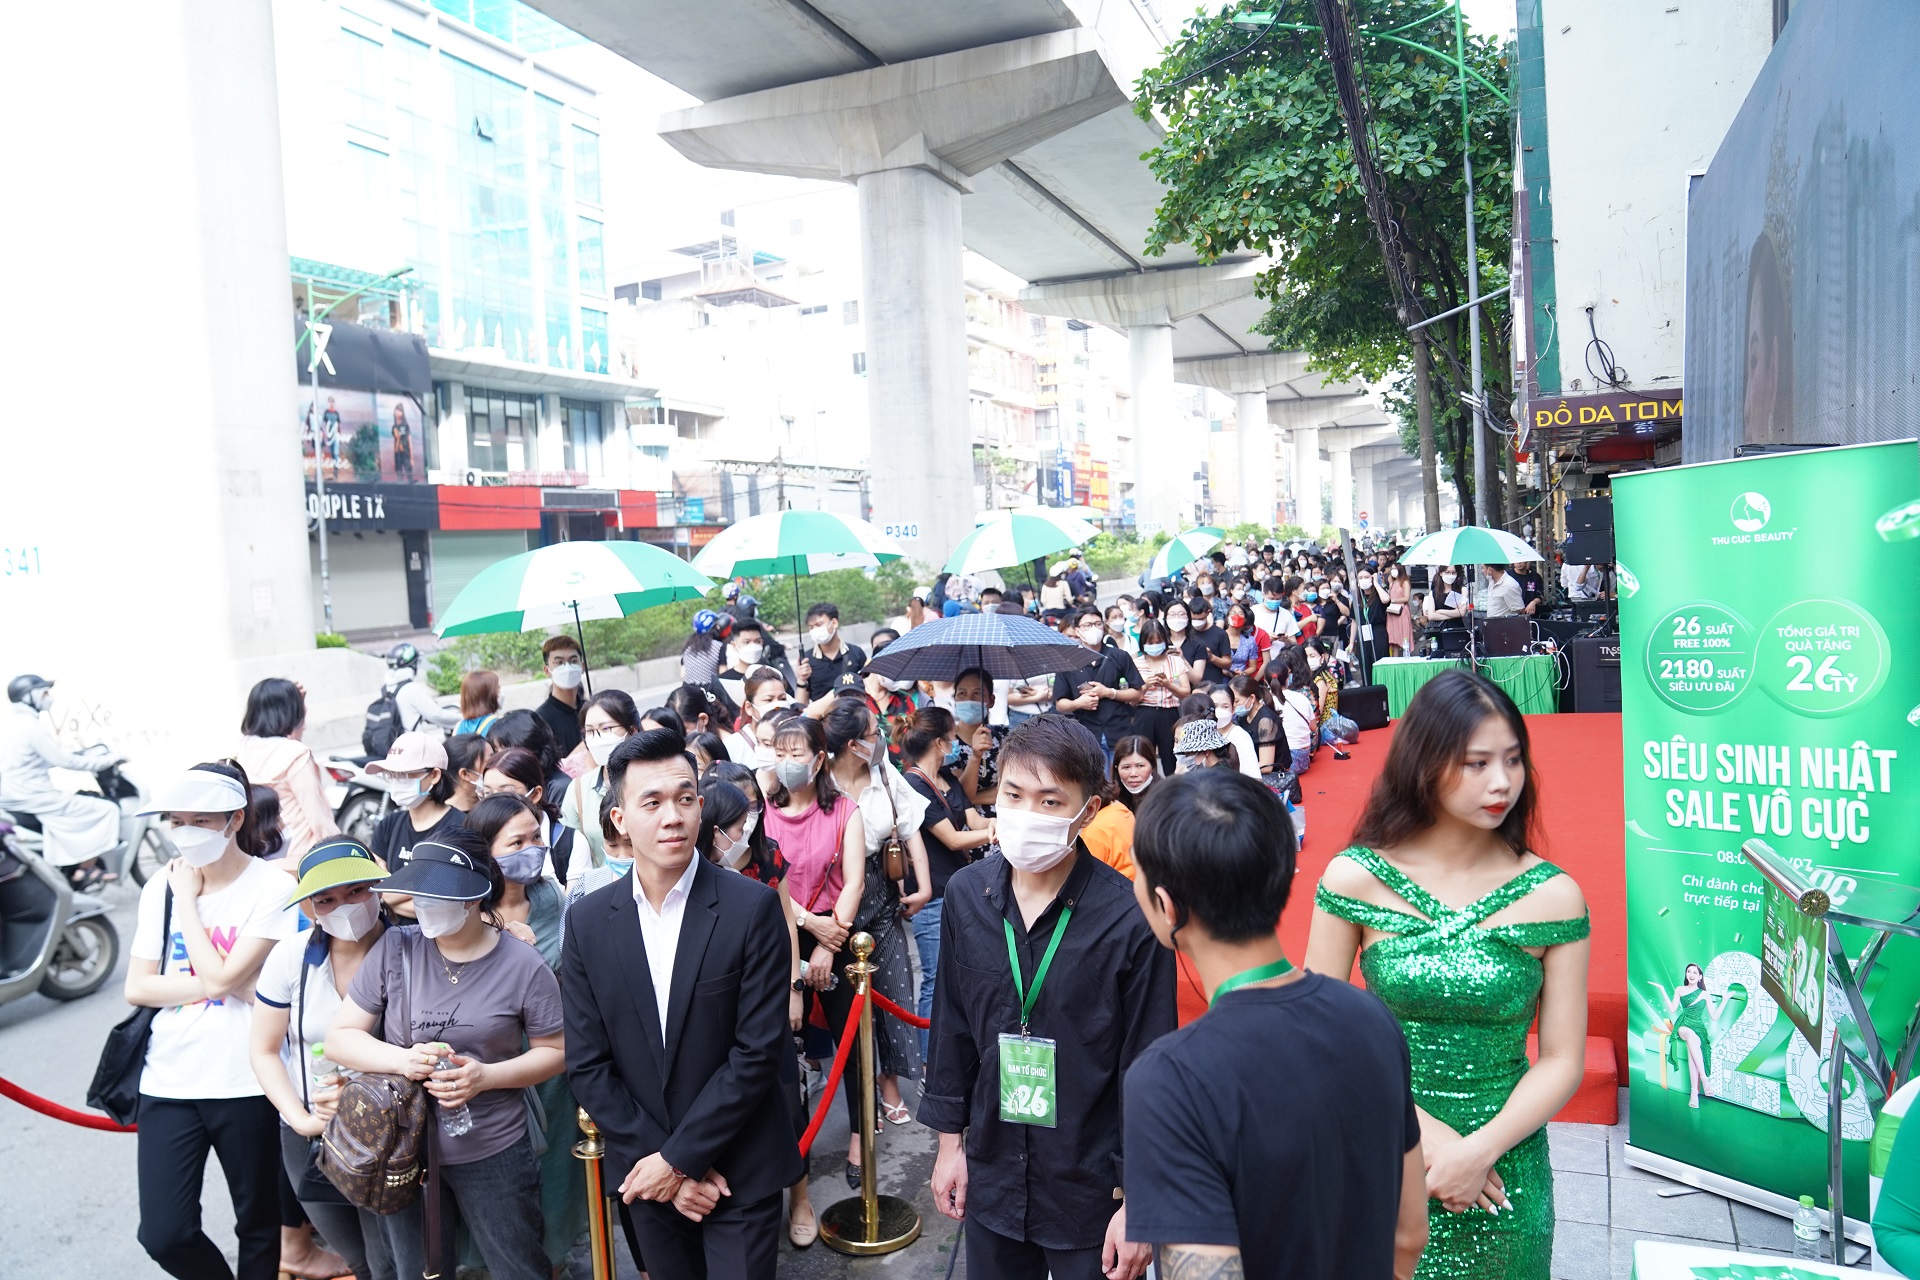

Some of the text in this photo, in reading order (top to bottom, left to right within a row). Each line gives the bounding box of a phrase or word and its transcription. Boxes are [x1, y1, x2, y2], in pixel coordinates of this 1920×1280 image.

[1535, 399, 1683, 427] ĐỒ DA TOM
[306, 493, 362, 519] OUPLE
[886, 525, 918, 539] P340
[1711, 531, 1794, 546] THU CUC BEAUTY
[1672, 615, 1735, 636] 26 SUẤT
[1776, 624, 1860, 639] TỔNG GIÁ TRỊ
[1673, 637, 1731, 649] FREE 100%
[1785, 639, 1852, 652] QUÀ TẶNG
[1659, 658, 1747, 679] 2180 SUẤT
[1785, 654, 1843, 692] 26
[1668, 679, 1736, 692] SIÊU ƯU ĐÃI
[1643, 734, 1898, 800] SIÊU SINH NHẬT
[1665, 787, 1870, 850] SALE VÔ CỰC
[1682, 874, 1704, 887] Chỉ
[1706, 877, 1739, 892] dành
[1683, 891, 1760, 912] trực tiếp tại
[1794, 934, 1821, 1027] 26
[411, 1002, 474, 1042] enough
[1007, 1063, 1047, 1078] BAN TỔ CHỨC
[1017, 1084, 1049, 1117] 26
